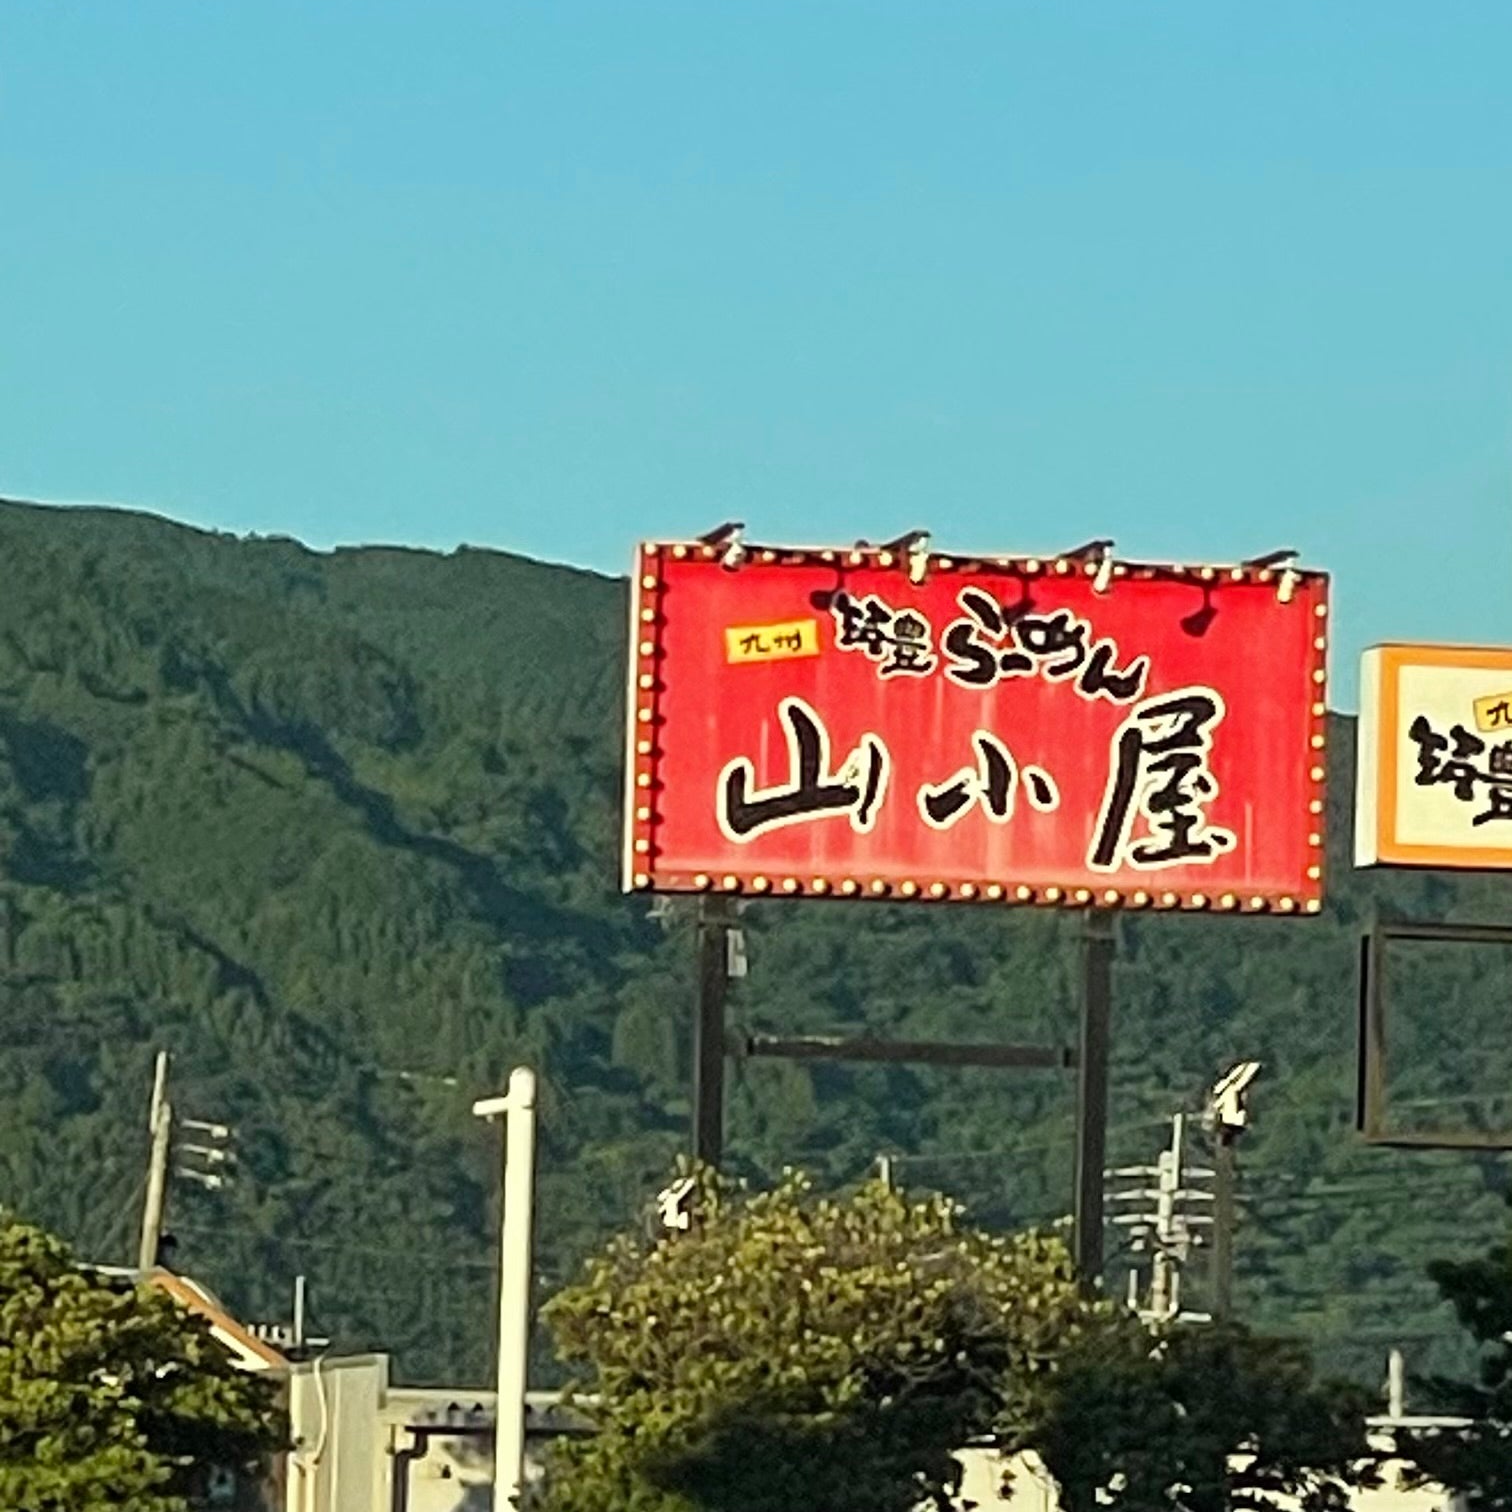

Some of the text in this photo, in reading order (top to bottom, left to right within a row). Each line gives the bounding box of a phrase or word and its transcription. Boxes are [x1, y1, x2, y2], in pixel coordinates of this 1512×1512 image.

[739, 628, 803, 655] 九州
[724, 695, 1230, 868] 山小屋
